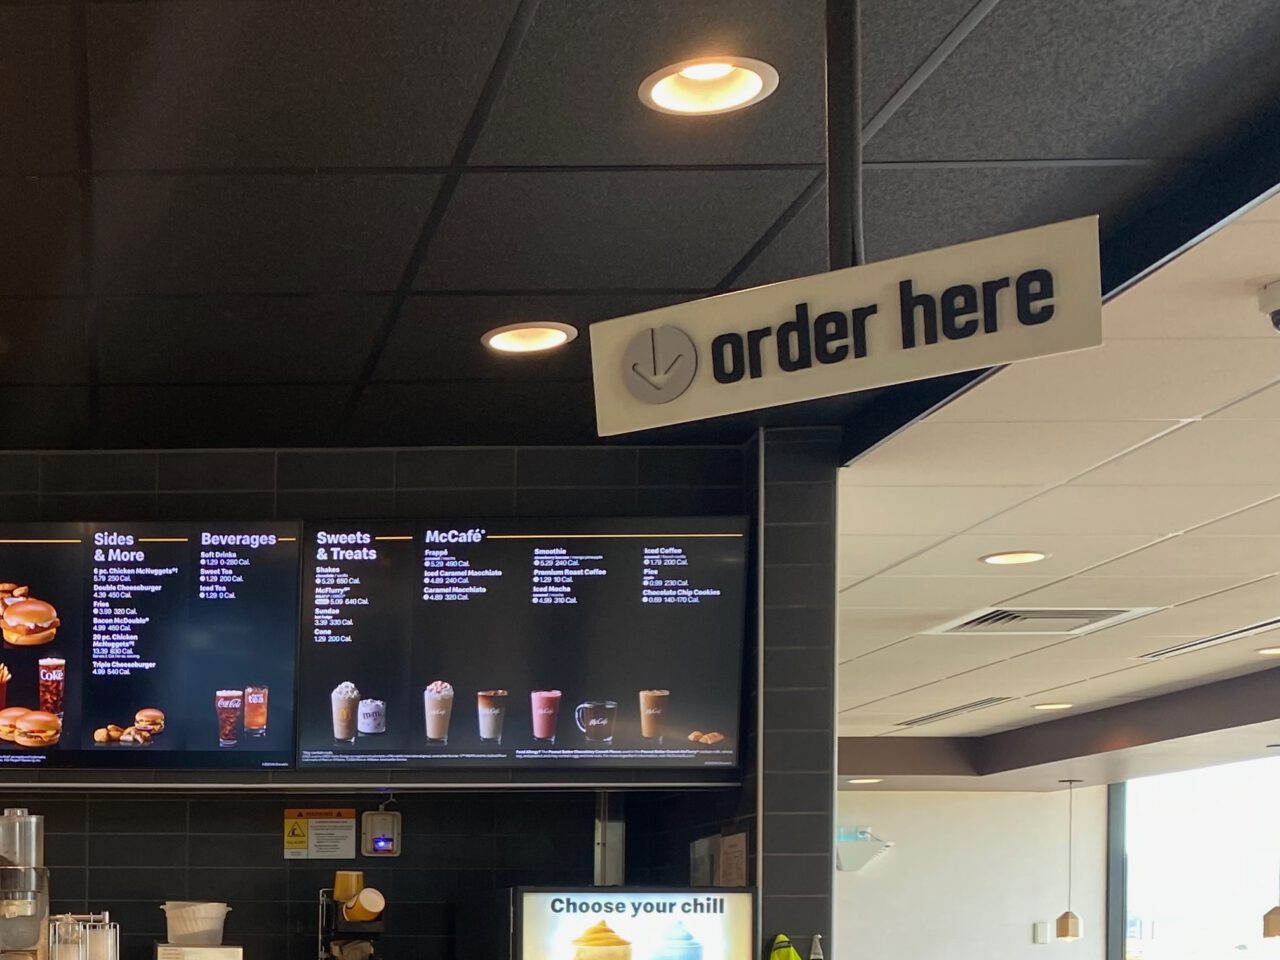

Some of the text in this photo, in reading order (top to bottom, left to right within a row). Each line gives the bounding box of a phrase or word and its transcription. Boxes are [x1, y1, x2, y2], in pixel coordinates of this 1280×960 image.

[711, 268, 1054, 384] order here
[94, 532, 134, 545] Sides
[201, 532, 276, 548] Beverages
[317, 531, 371, 544] Sweets
[94, 549, 144, 561] & More
[316, 547, 377, 560] & Treats
[117, 584, 161, 592] Cheeseburger
[111, 661, 156, 669] Cheeseburger
[40, 670, 63, 681] Coke
[551, 898, 725, 918] Choose your chill
